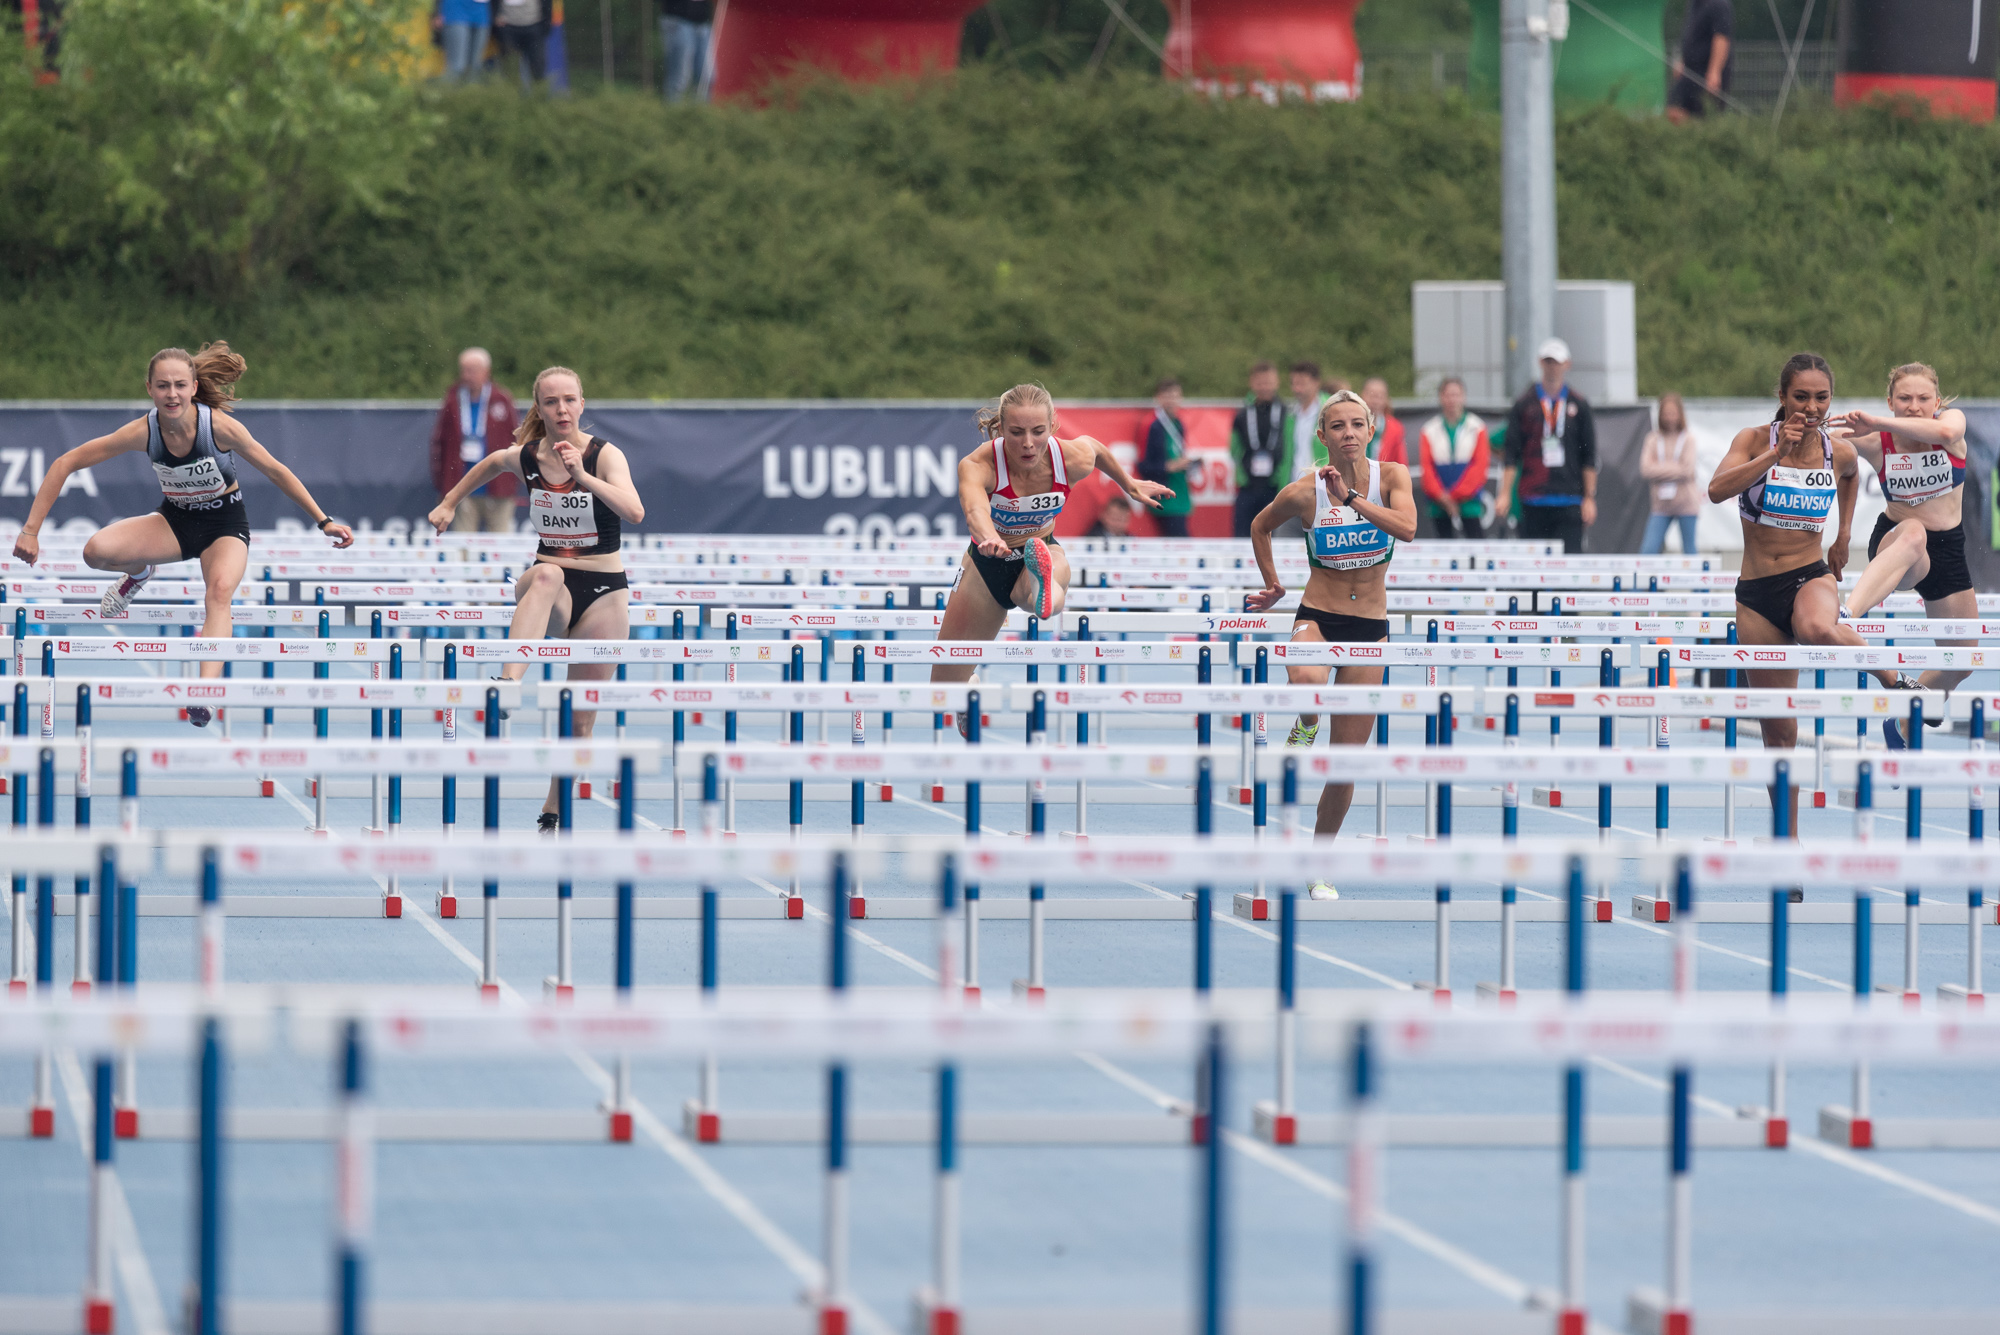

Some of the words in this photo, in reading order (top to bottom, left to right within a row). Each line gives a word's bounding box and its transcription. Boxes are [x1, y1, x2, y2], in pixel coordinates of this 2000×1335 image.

[1922, 454, 1947, 468] 181
[185, 462, 214, 476] 702
[763, 445, 958, 499] LUBLIN
[1806, 472, 1833, 486] 600
[1889, 470, 1950, 490] PAWŁOW
[201, 493, 217, 501] 2021
[561, 496, 588, 509] 305
[1031, 495, 1060, 510] 331
[1766, 492, 1832, 511] MAJEWSKA
[188, 500, 223, 511] PRO
[535, 500, 552, 508] ORLEN
[542, 514, 580, 529] BANY
[994, 511, 1055, 524] NAGIĘĆ
[1322, 518, 1342, 526] ORLEN
[998, 526, 1022, 535] LUBLIN
[1776, 520, 1801, 528] LUBLIN
[1802, 522, 1820, 532] 2021
[1326, 529, 1379, 548] BARCZ
[1333, 560, 1357, 568] LUBLIN
[1358, 558, 1375, 567] 2021
[808, 616, 834, 624] ORLEN
[1219, 618, 1268, 630] polanik
[135, 644, 165, 652] ORLEN
[540, 648, 569, 656] ORLEN
[952, 648, 981, 656] ORLEN
[1351, 648, 1380, 656] ORLEN
[1756, 652, 1785, 660] ORLEN
[189, 687, 224, 697] ORLEN
